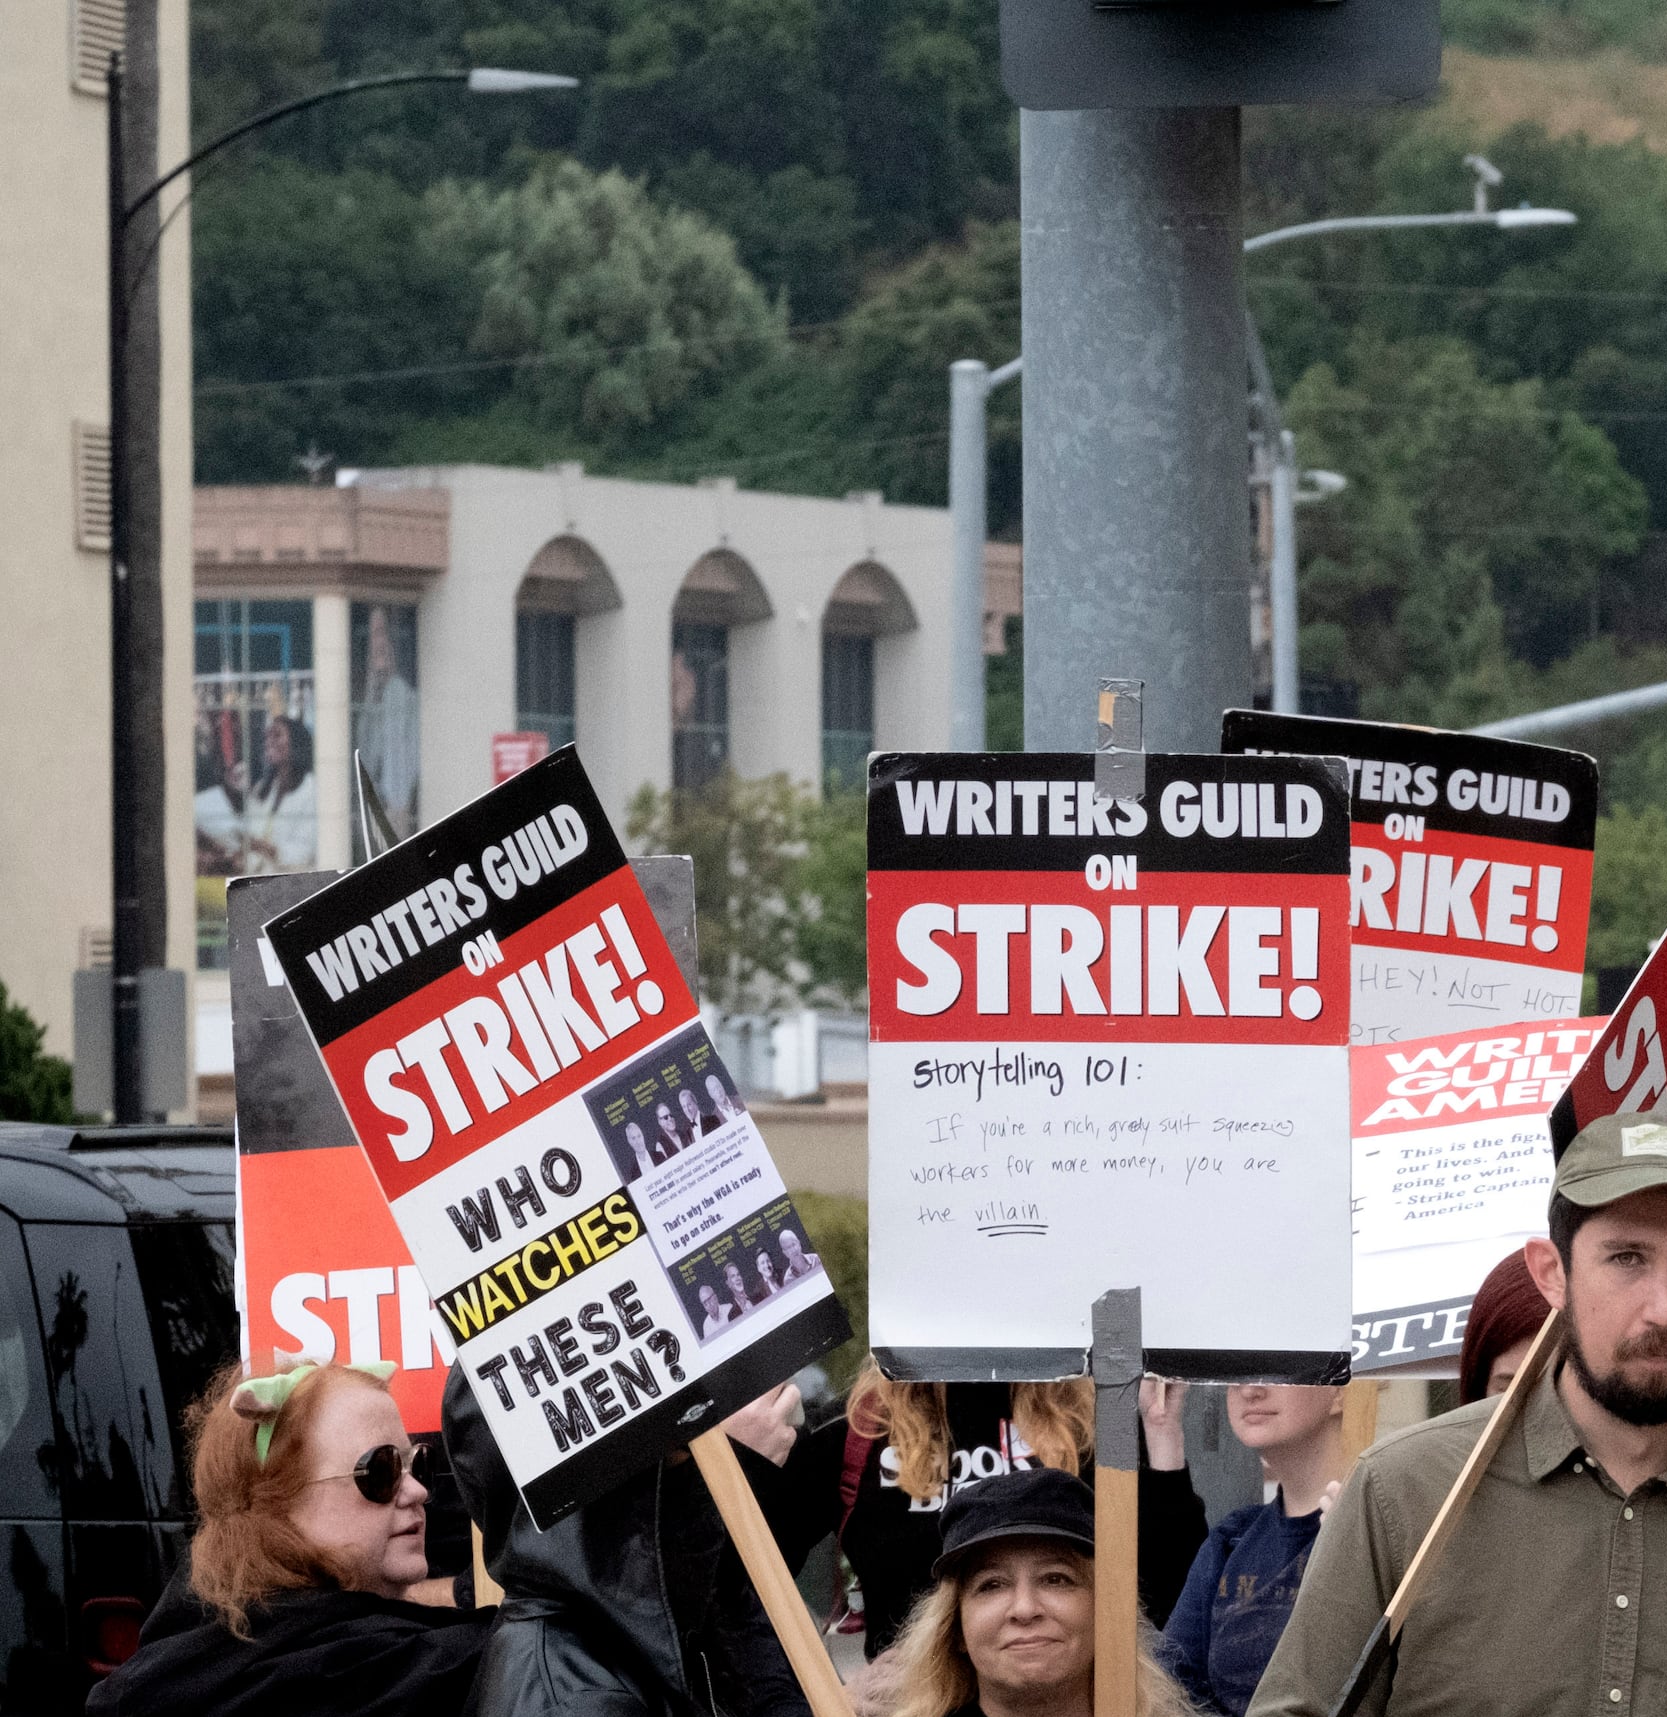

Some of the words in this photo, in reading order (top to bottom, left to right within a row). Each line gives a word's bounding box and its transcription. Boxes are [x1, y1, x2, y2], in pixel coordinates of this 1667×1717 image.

[896, 780, 1146, 837] WRITERS
[1161, 782, 1322, 838] GUILD
[1447, 770, 1570, 823] GUILD
[1384, 813, 1424, 842] ON
[1085, 854, 1137, 890] ON
[306, 864, 488, 1002] WRITERS
[481, 803, 589, 901] GUILD
[1349, 849, 1563, 952] RIKE!
[461, 929, 505, 977] ON
[896, 902, 1323, 1021] STRIKE!
[1360, 964, 1437, 996] HEY!
[1449, 968, 1511, 1002] NOT
[362, 903, 666, 1162] STRIKE!
[1385, 1029, 1604, 1073] WRIT
[1387, 1054, 1587, 1096] GUIL
[926, 1113, 964, 1143] If
[980, 1115, 1025, 1151] you're
[1043, 1121, 1051, 1136] a
[1064, 1115, 1100, 1139] rich,
[1160, 1110, 1200, 1134] suit
[1400, 1146, 1442, 1159] This
[1450, 1143, 1466, 1152] is
[1473, 1137, 1503, 1148] the
[1511, 1133, 1546, 1143] figh
[910, 1163, 989, 1184] workers
[1007, 1155, 1034, 1177] for
[1052, 1159, 1089, 1173] more
[1103, 1155, 1164, 1178] money,
[1186, 1156, 1223, 1185] you
[1244, 1157, 1280, 1173] are
[1392, 1177, 1445, 1192] going
[1453, 1174, 1471, 1182] to
[1480, 1166, 1520, 1177] win.
[1397, 1163, 1430, 1175] our
[1436, 1159, 1488, 1169] lives.
[1496, 1147, 1534, 1160] And
[445, 1146, 580, 1253] WHO
[662, 1210, 687, 1234] That's
[686, 1203, 703, 1222] why
[702, 1196, 715, 1212] the
[714, 1182, 732, 1203] WGA
[731, 1180, 740, 1191] is
[740, 1167, 762, 1185] ready
[1404, 1201, 1485, 1220] America
[1408, 1190, 1466, 1205] Strike
[1474, 1176, 1550, 1193] Captain
[670, 1238, 680, 1250] to
[679, 1233, 690, 1248] go
[690, 1228, 700, 1239] on
[700, 1215, 725, 1232] strike.
[918, 1206, 955, 1225] the
[439, 1194, 641, 1339] WATCHES
[477, 1279, 653, 1411] THESE
[541, 1327, 686, 1453] MEN?
